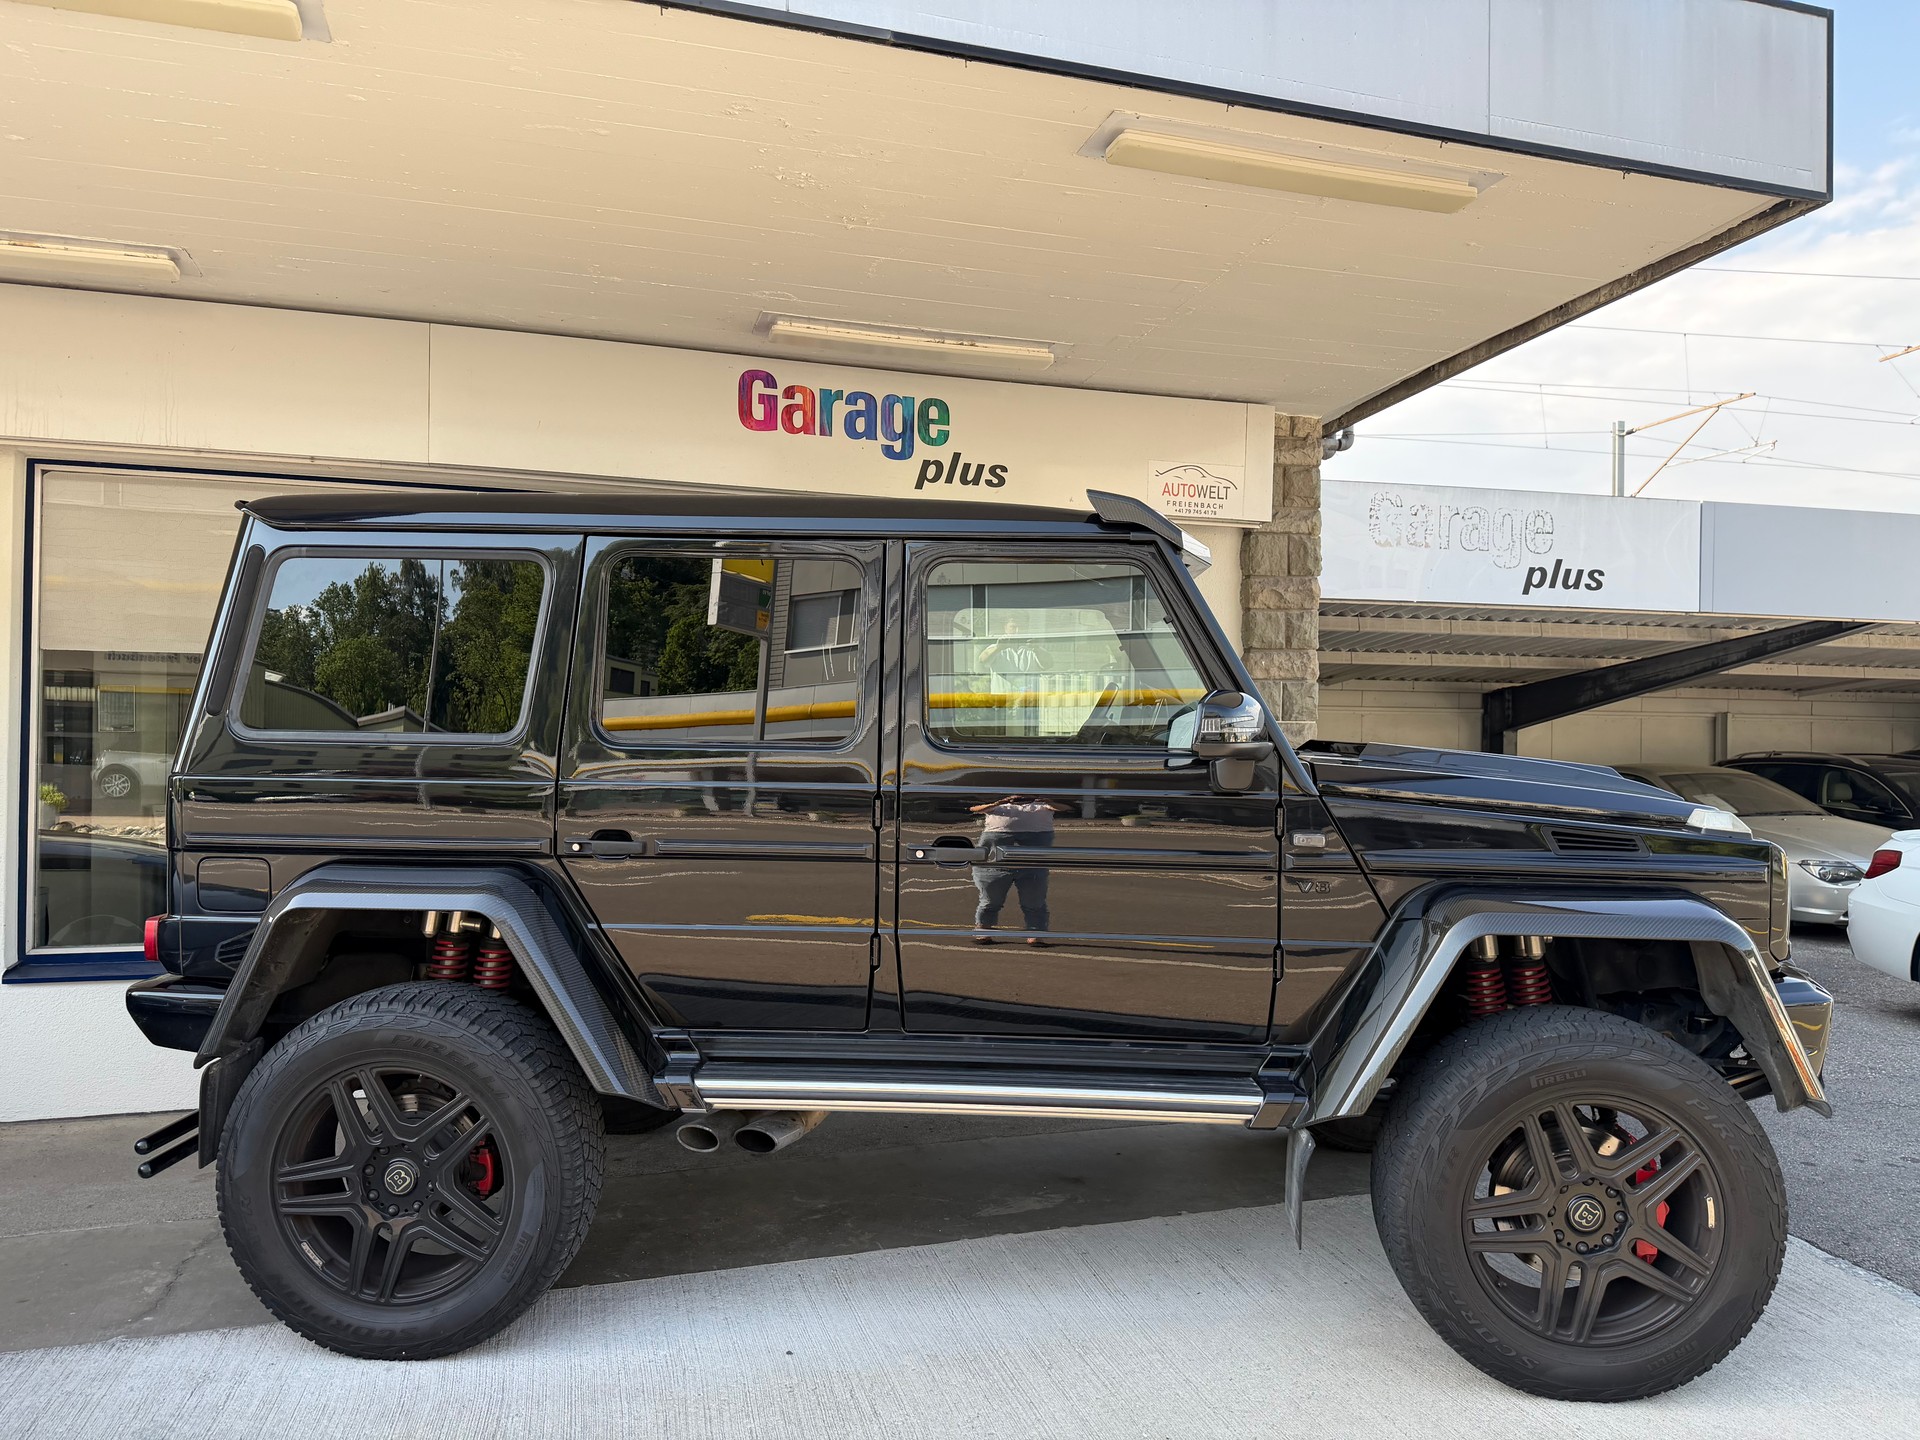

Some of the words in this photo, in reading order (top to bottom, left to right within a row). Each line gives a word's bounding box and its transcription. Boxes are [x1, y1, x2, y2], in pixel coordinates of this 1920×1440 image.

[738, 369, 950, 461] Garage
[914, 452, 1009, 490] plus
[1161, 482, 1231, 500] AUTOWELT
[1166, 500, 1224, 510] FREIENBACH
[1522, 559, 1606, 595] plus
[1296, 881, 1330, 894] V8
[391, 1034, 510, 1100] PIRELLI
[1529, 1067, 1588, 1089] PIRELLI
[1684, 1098, 1766, 1218] PIRELLI
